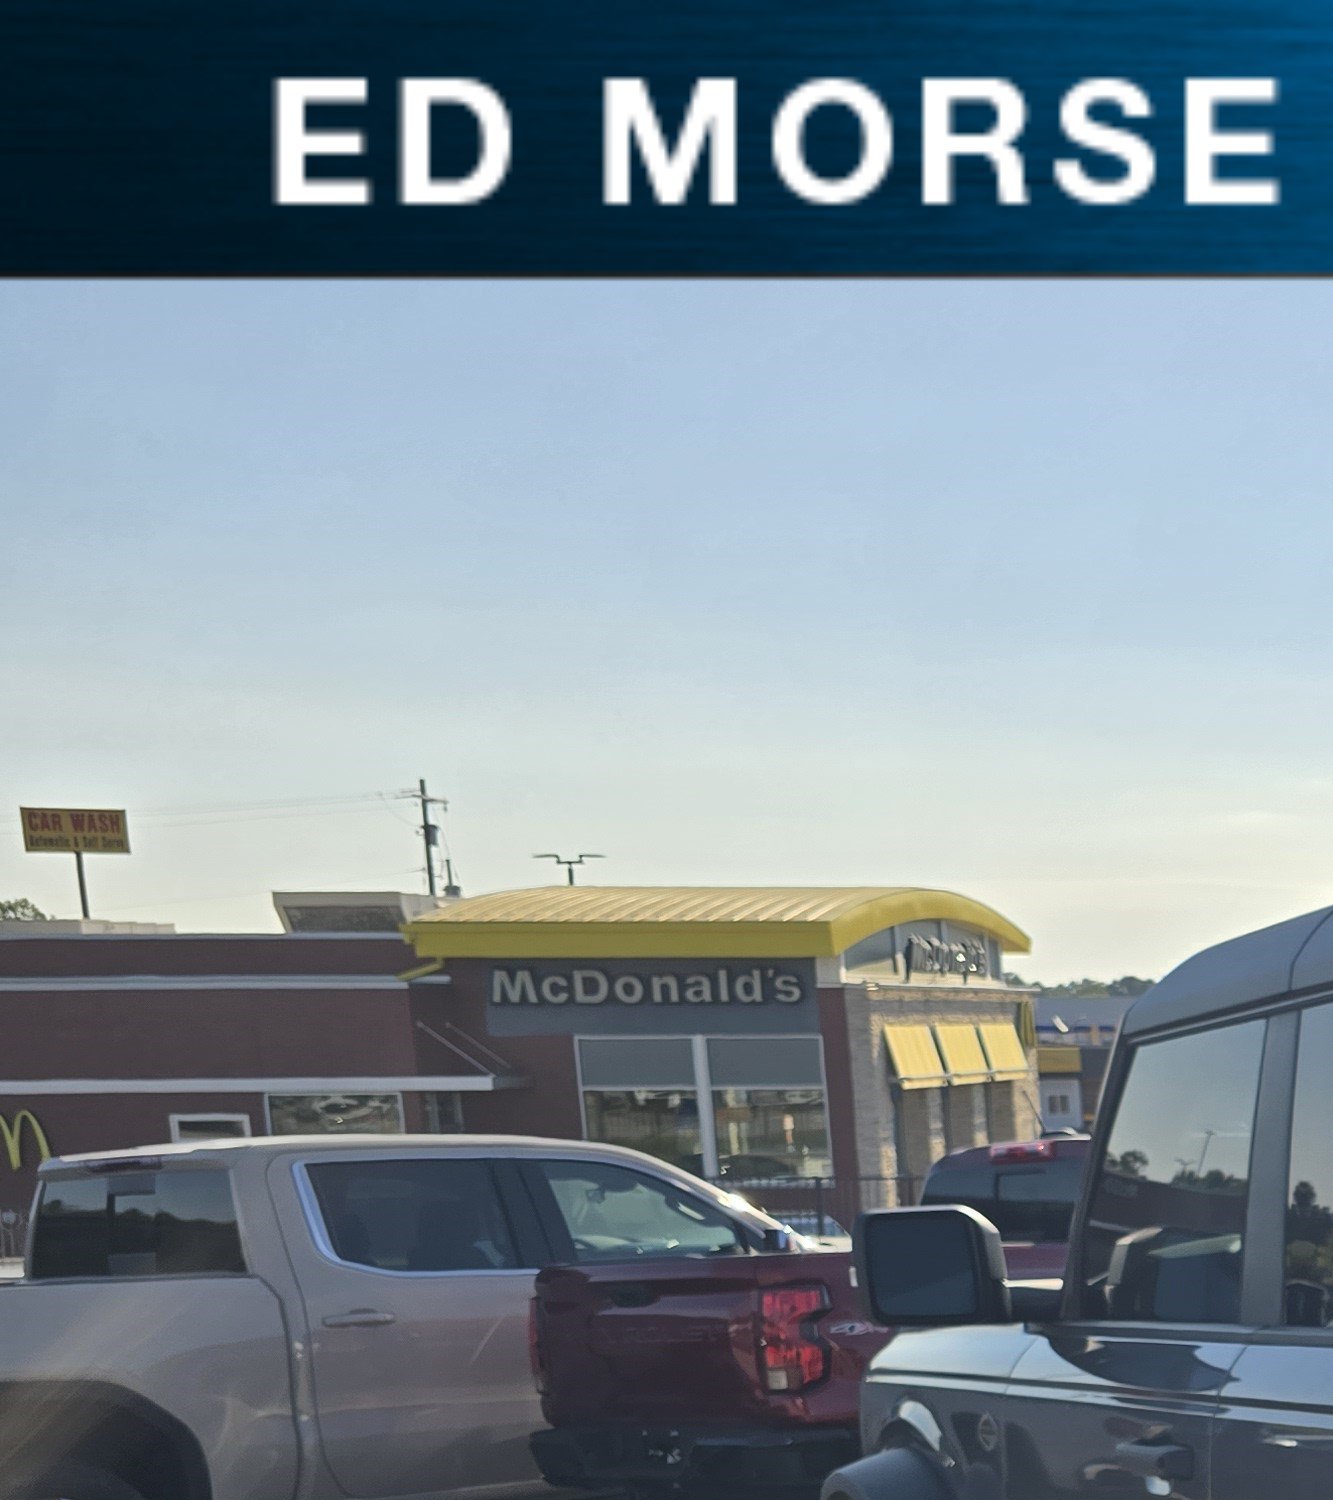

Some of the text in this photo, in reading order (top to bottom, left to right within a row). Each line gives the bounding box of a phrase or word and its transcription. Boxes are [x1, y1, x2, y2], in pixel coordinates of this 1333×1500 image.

[28, 811, 121, 834] CAR WASH
[492, 969, 802, 1004] McDonald's
